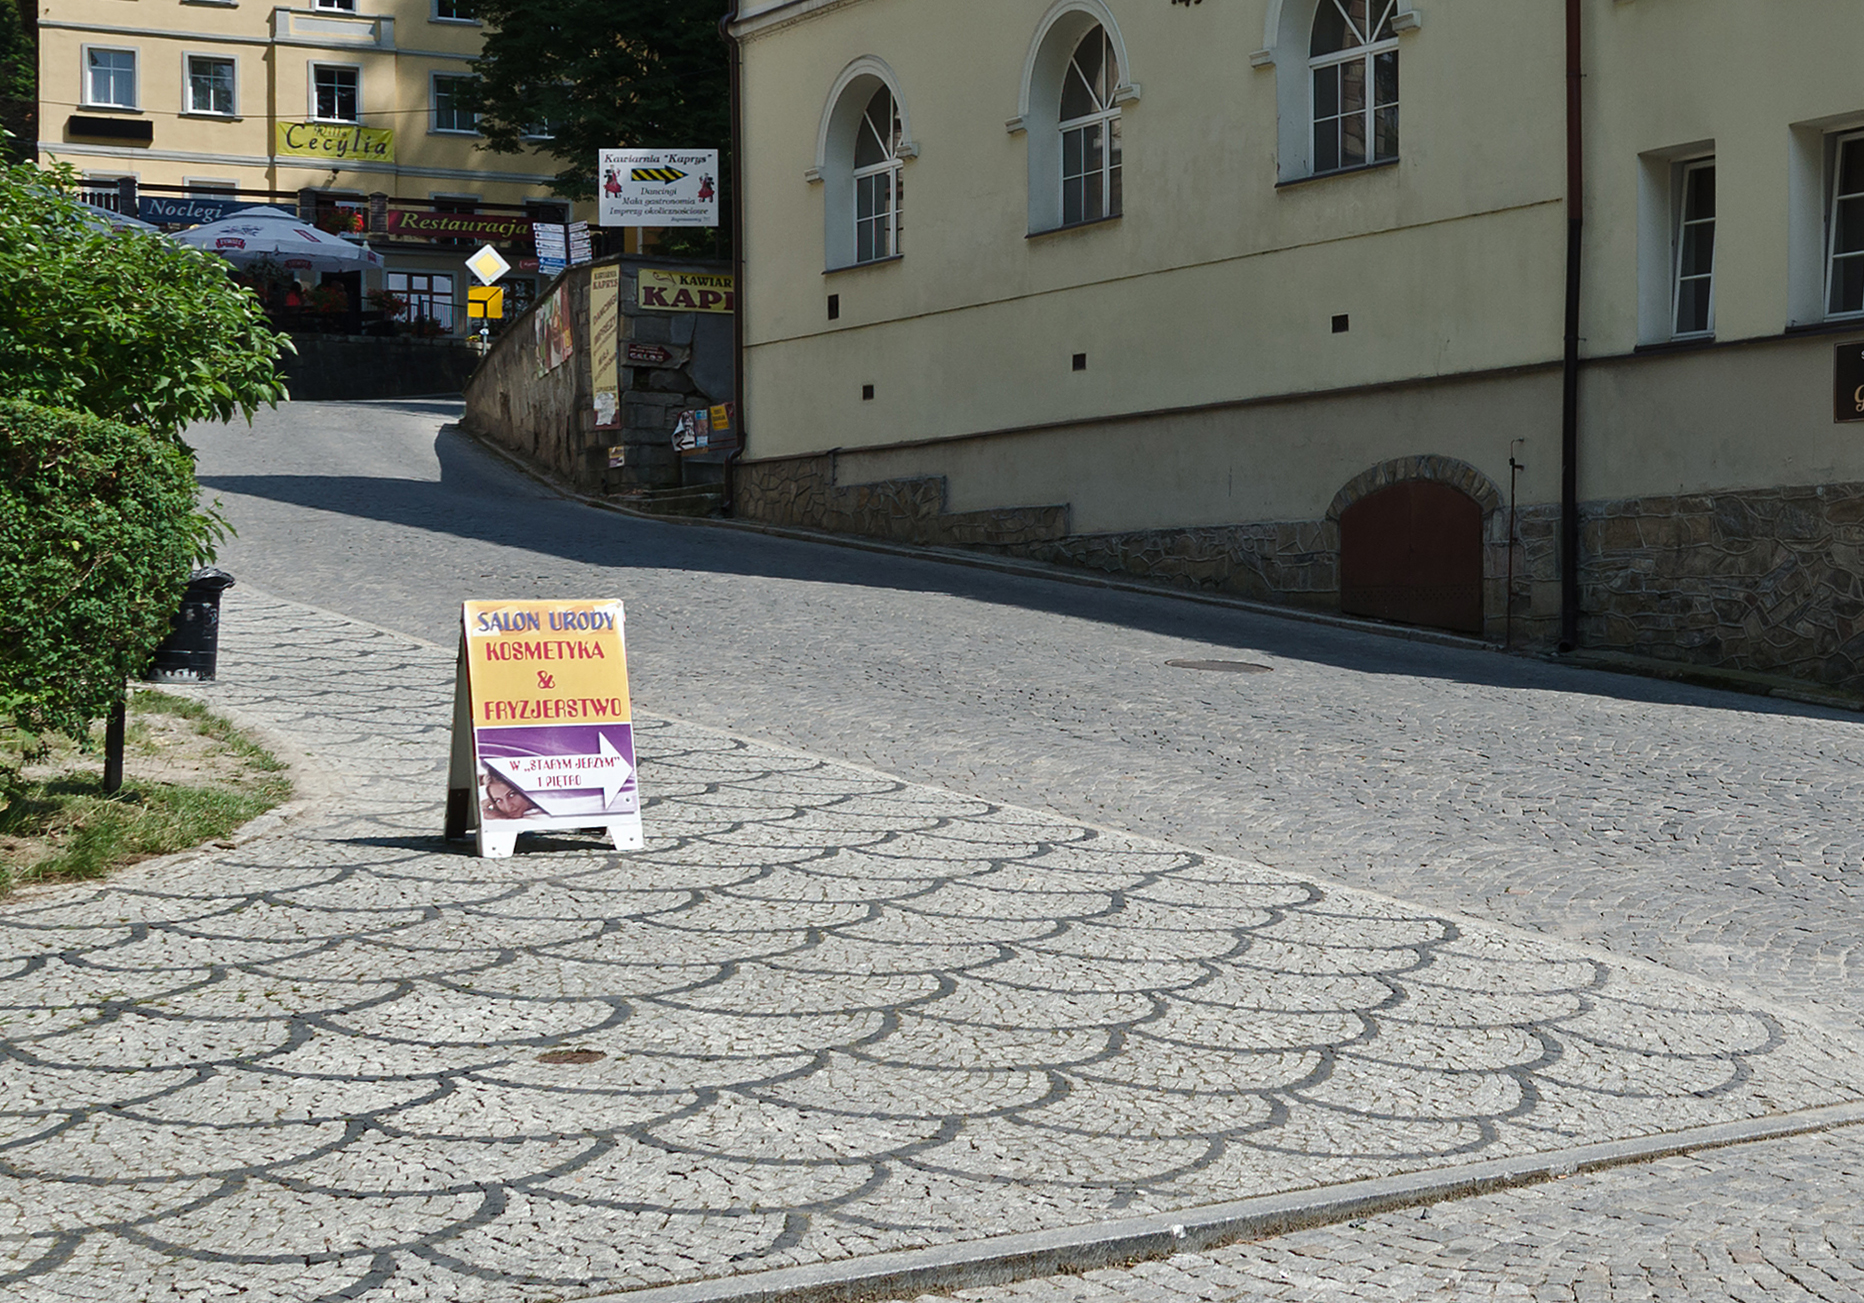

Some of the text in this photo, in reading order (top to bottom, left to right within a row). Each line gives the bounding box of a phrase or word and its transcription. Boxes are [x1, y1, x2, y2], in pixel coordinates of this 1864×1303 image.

[286, 123, 387, 157] Cecylia
[604, 153, 660, 163] Kawiarnia
[640, 187, 677, 196] Dancingi
[147, 199, 223, 222] Noclegi
[609, 207, 642, 216] Imprezy
[644, 198, 696, 206] gastronomia
[400, 212, 529, 237] Restauracja
[477, 610, 617, 632] SALON URODY
[485, 640, 605, 661] KOSMETYKA
[536, 670, 556, 690] &
[484, 698, 622, 721] FRYZJERSTWO
[509, 760, 521, 772] W
[546, 774, 582, 789] PIĘTRO
